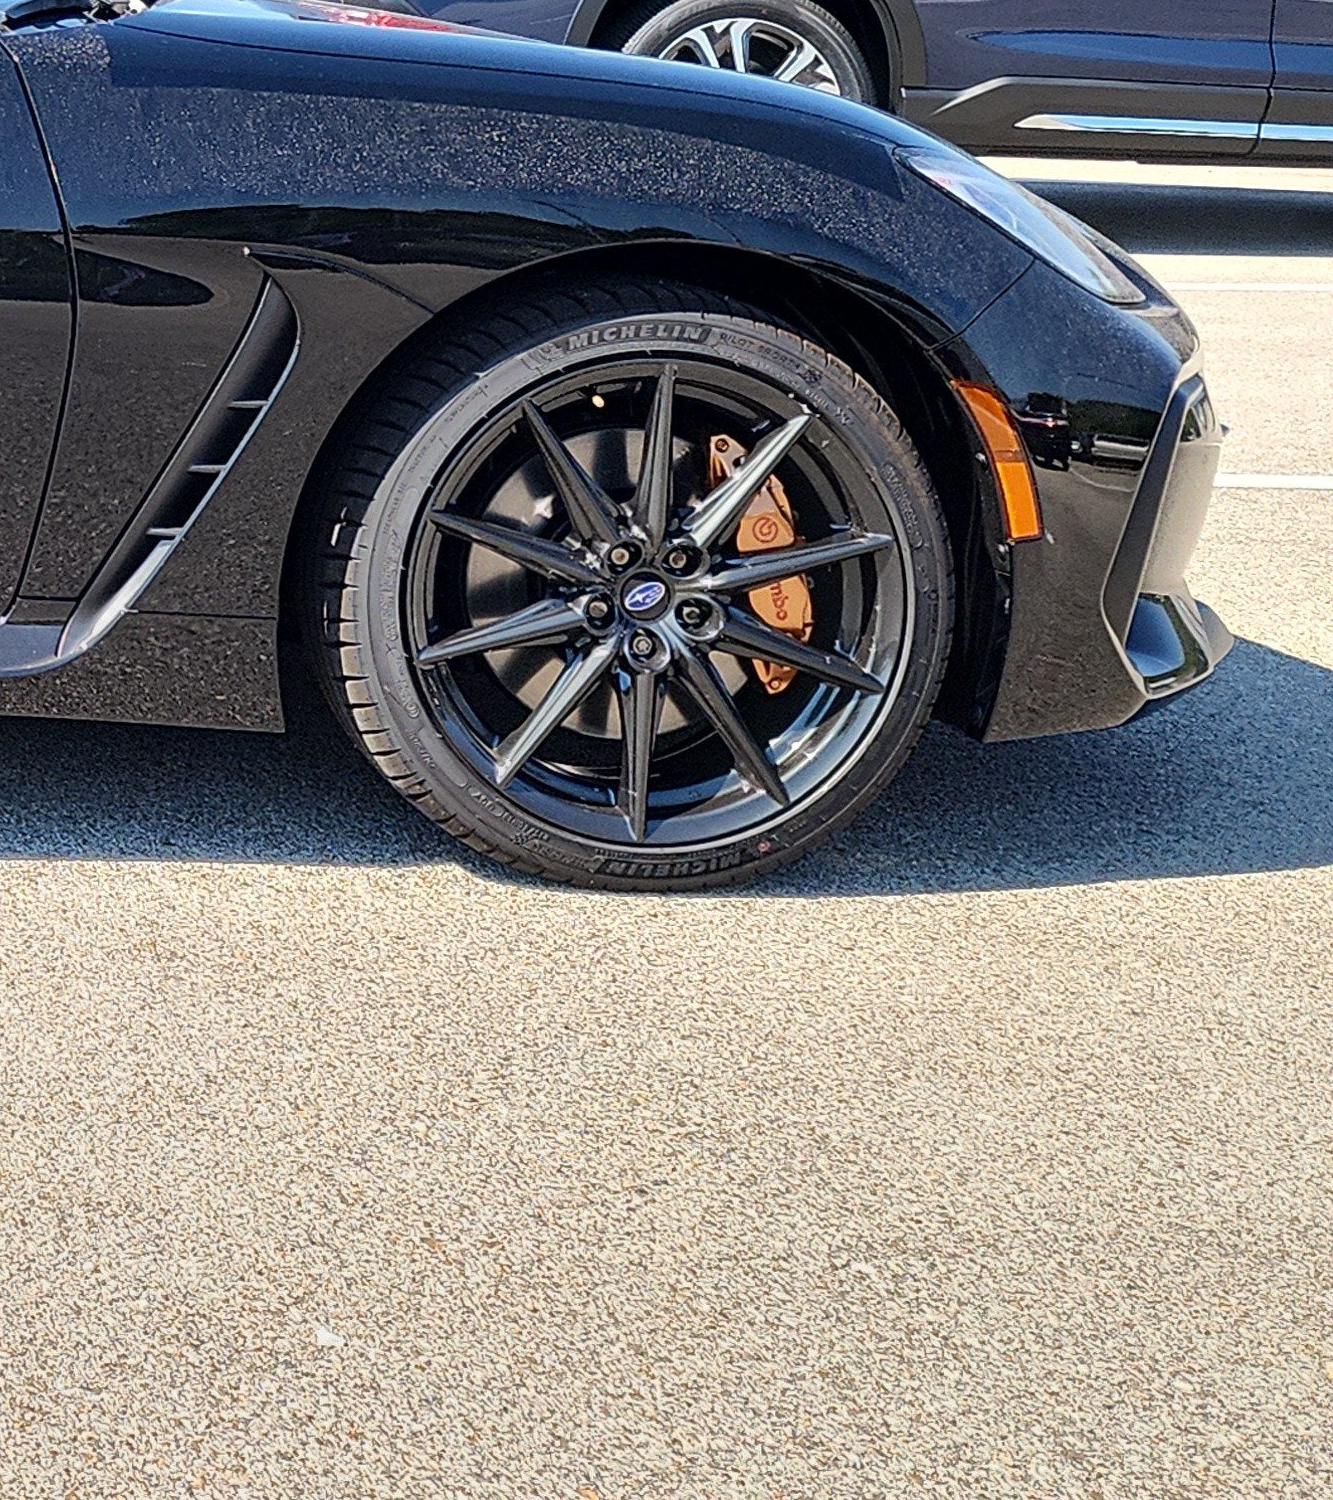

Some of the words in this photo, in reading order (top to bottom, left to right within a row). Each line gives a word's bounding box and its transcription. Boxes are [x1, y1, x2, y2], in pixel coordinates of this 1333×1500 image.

[568, 322, 702, 350] MICHELIN
[770, 581, 789, 621] mbo
[606, 851, 741, 878] MICHELIN
